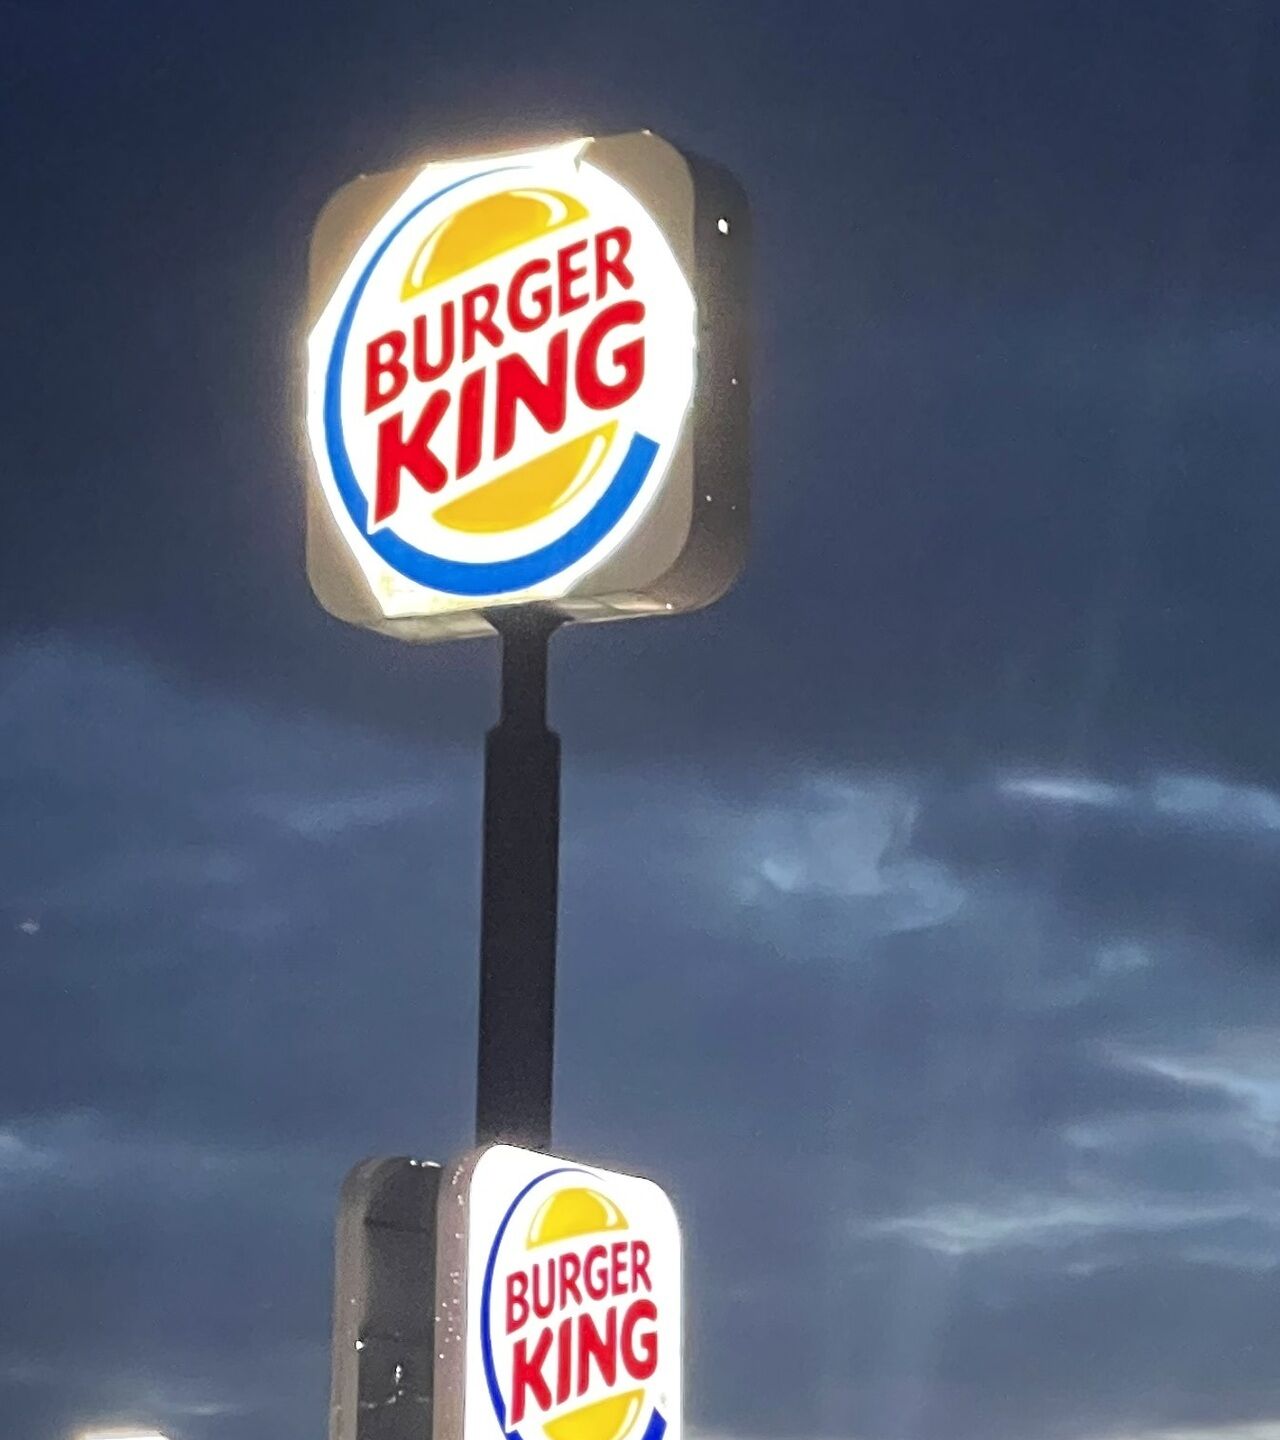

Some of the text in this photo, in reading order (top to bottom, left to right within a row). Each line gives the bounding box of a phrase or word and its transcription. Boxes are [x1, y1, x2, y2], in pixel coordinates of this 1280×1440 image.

[363, 225, 635, 415] BURGER
[374, 299, 646, 525] KING
[505, 1239, 653, 1336] BURGER
[510, 1299, 659, 1425] KING
